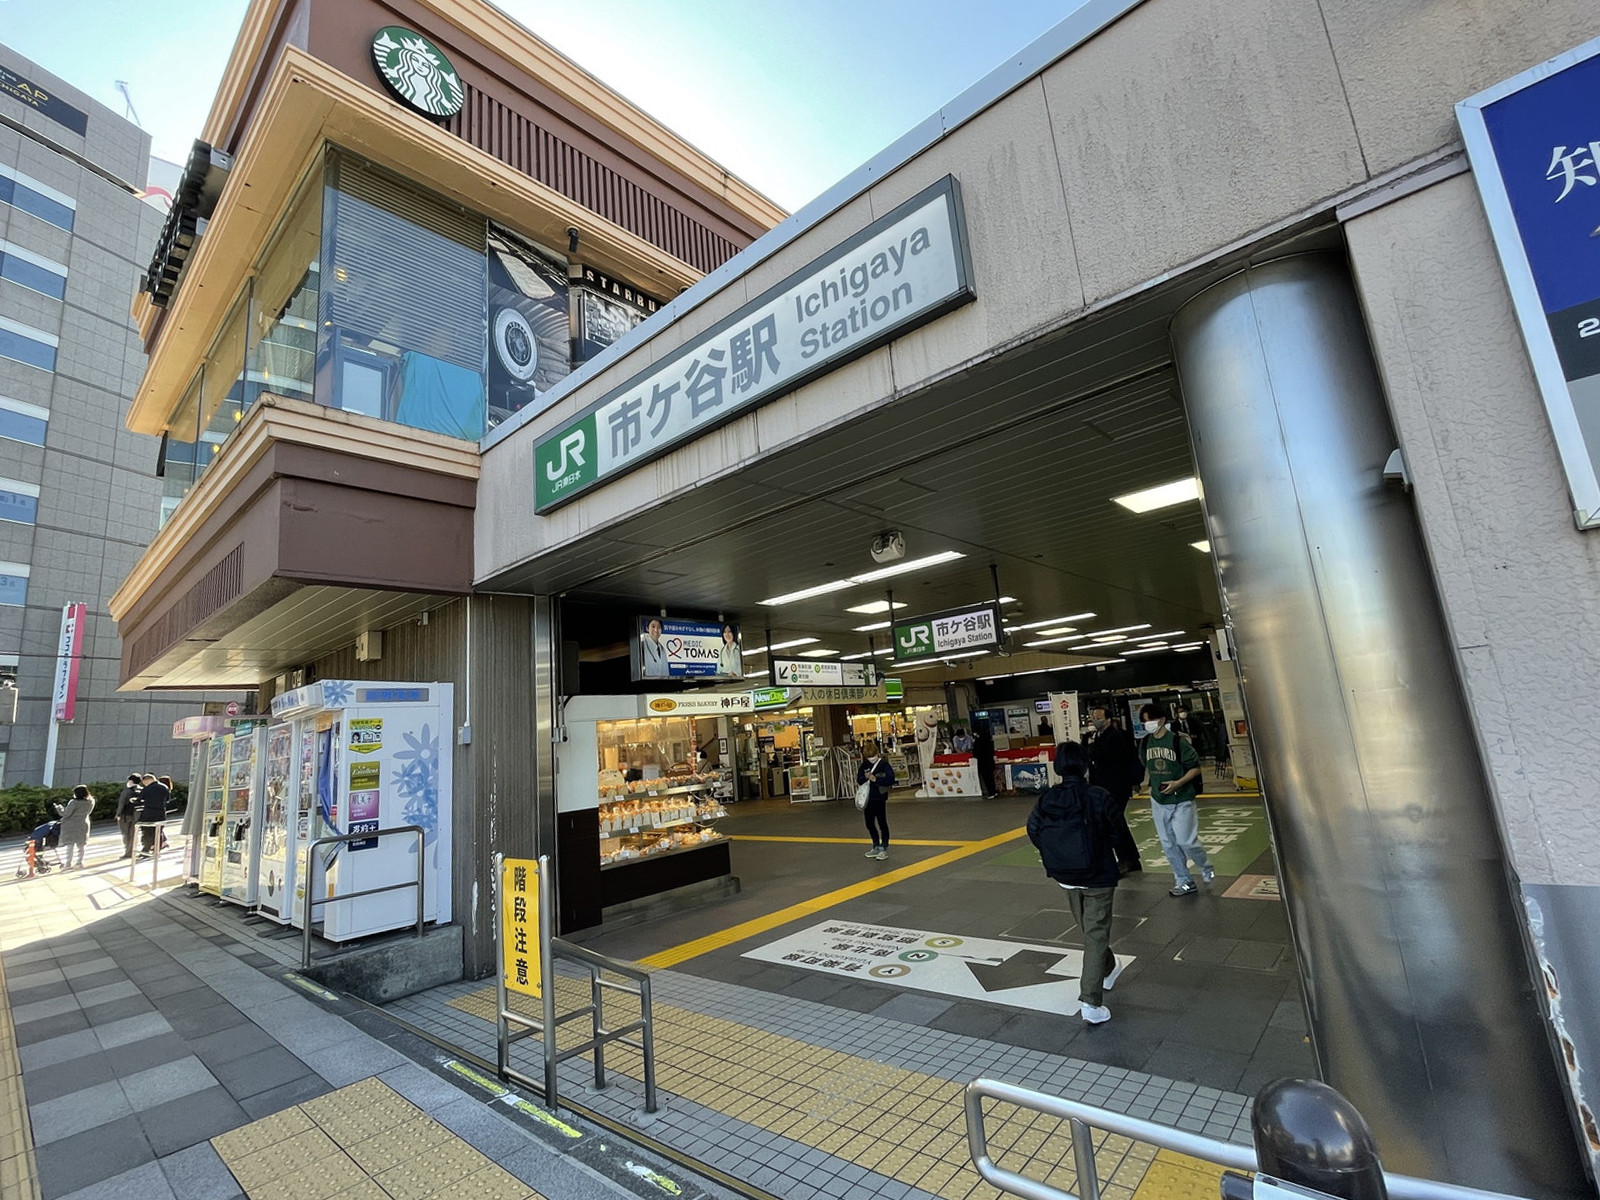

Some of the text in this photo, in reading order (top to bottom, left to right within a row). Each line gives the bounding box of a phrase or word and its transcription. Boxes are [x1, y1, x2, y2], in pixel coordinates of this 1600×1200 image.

[17, 83, 48, 101] AP
[795, 226, 931, 324] Ichigaya
[586, 269, 664, 313] STARBU
[799, 282, 914, 360] Station
[608, 313, 781, 459] 市ケ谷駅
[546, 428, 586, 481] JR
[551, 469, 582, 494] JR東日本
[900, 624, 930, 648] JR
[936, 613, 992, 637] 市ケ谷駅
[937, 631, 992, 649] Ichigaya Station
[684, 648, 719, 659] TOMAS
[755, 689, 789, 703] NewDays
[513, 865, 528, 986] 階段注意
